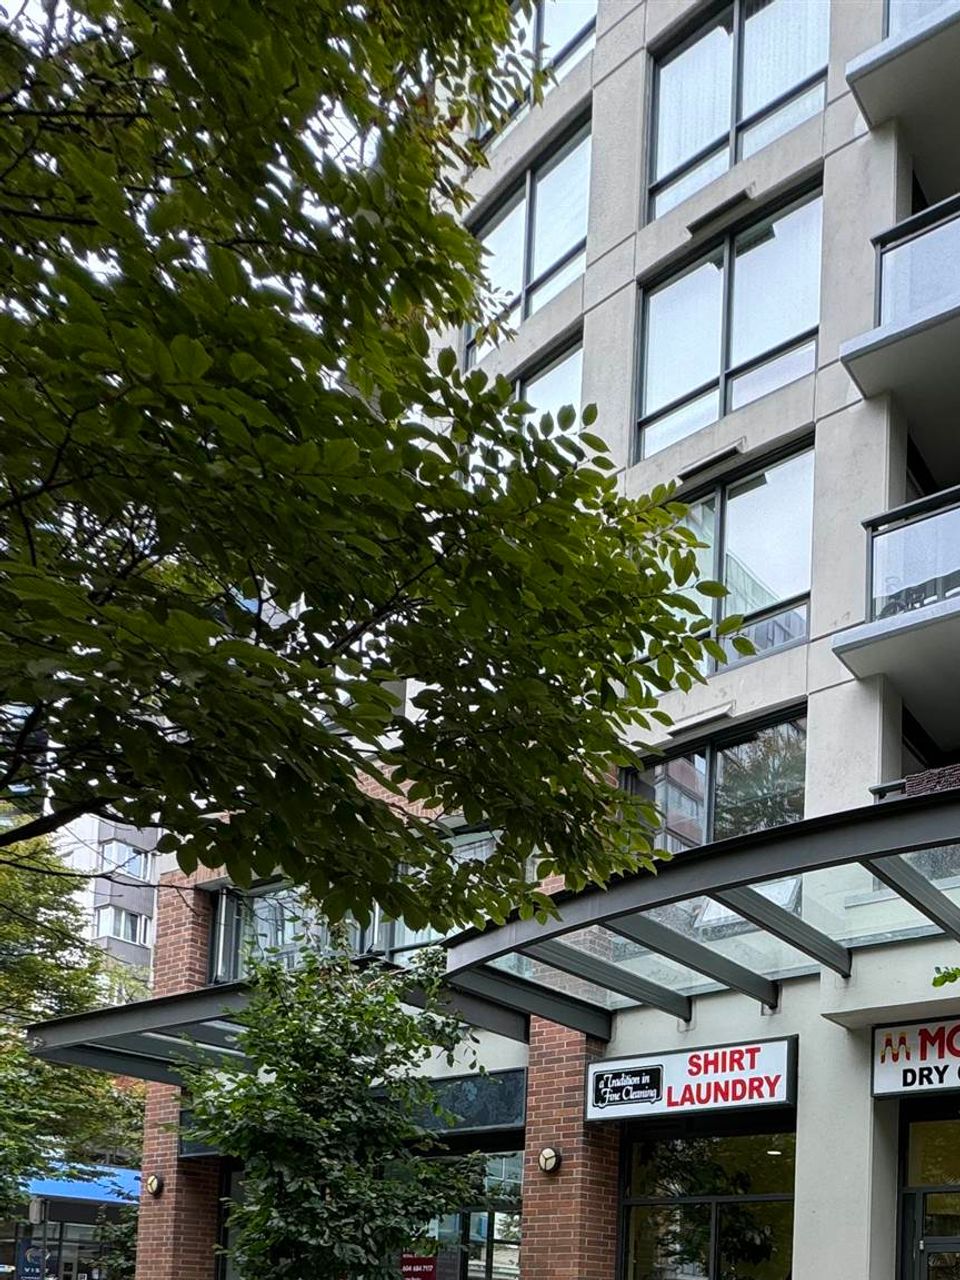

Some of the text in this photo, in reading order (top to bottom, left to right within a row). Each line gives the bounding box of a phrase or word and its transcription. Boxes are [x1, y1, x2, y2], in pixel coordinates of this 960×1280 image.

[688, 1047, 761, 1077] SHIRT
[603, 1073, 640, 1088] Tradition
[641, 1073, 650, 1084] in
[902, 1064, 949, 1087] DRY
[601, 1085, 658, 1103] Fine Cleaning
[666, 1075, 782, 1108] LAUNDRY
